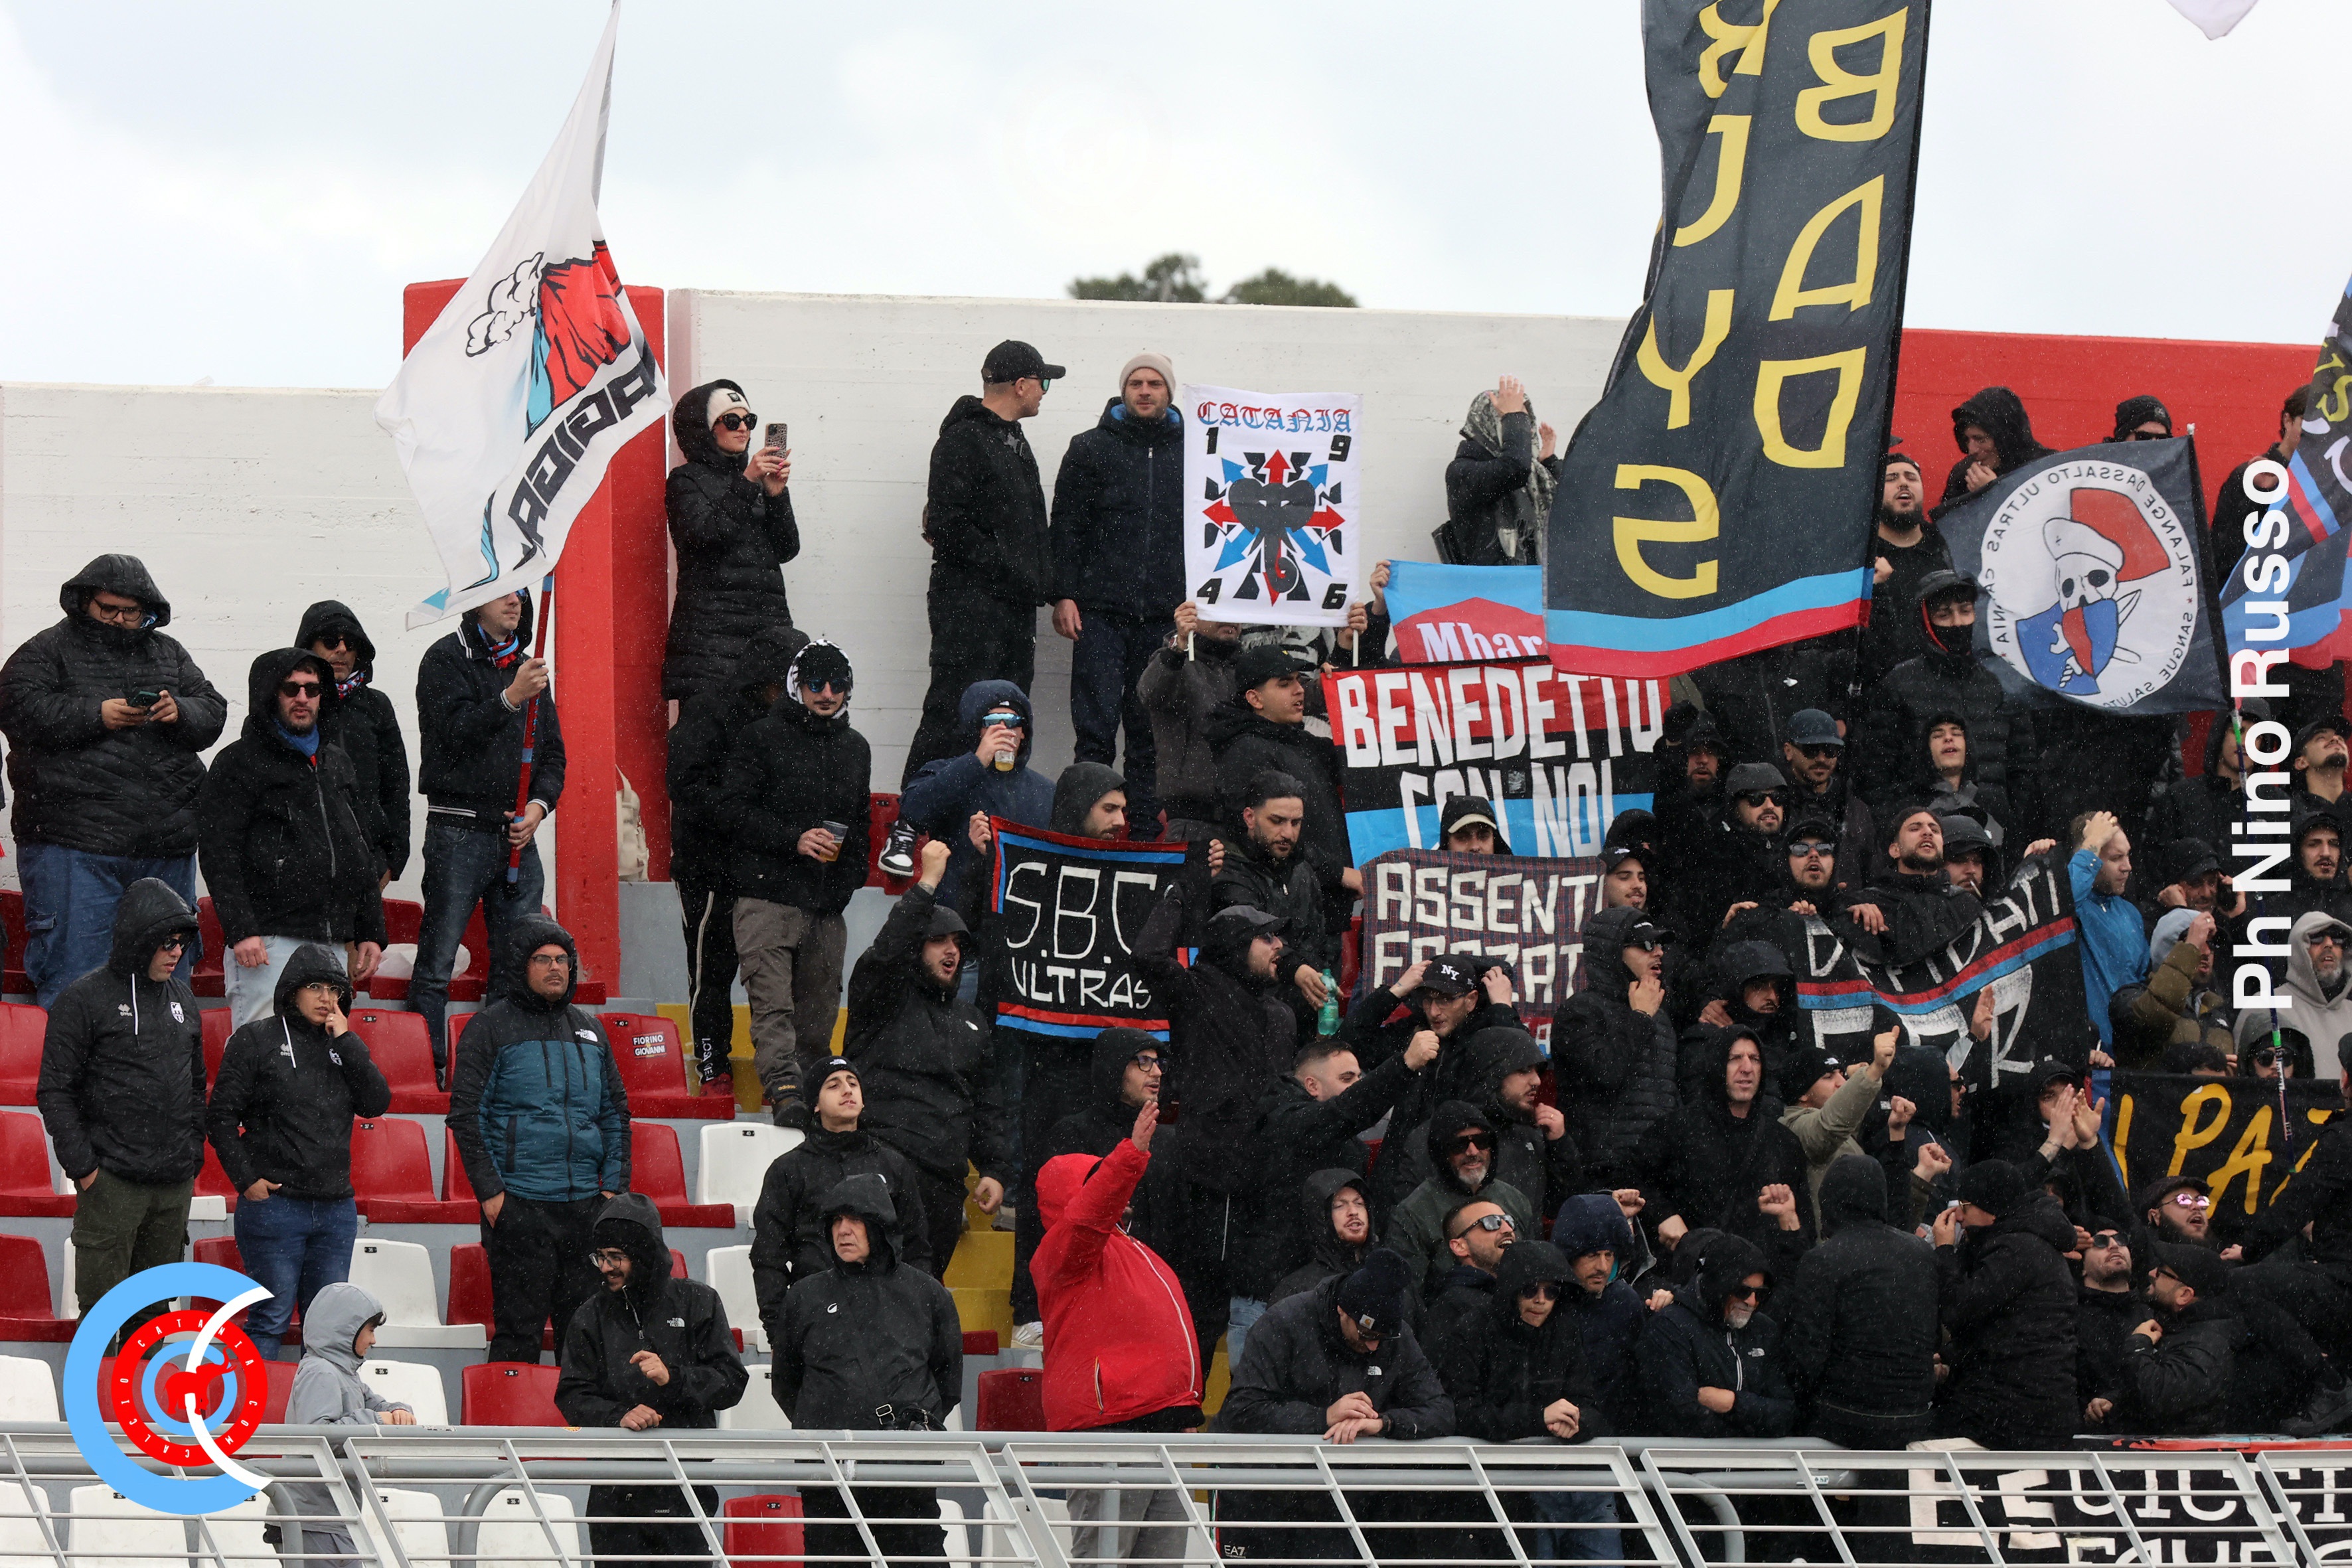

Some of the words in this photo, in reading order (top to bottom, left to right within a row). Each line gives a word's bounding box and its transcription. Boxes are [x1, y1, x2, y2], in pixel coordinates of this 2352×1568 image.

[1197, 402, 1352, 433] CATANIA
[1206, 427, 1219, 455] 1
[1328, 435, 1352, 461] 9
[1197, 578, 1222, 604] 4
[1322, 584, 1348, 609] 6
[1336, 665, 1664, 767] BENEDETTO
[1530, 759, 1614, 857] NOI
[1441, 965, 1460, 980] NY
[633, 1034, 664, 1045] FIORINO
[635, 1045, 666, 1056] GIOVANNI
[1224, 1545, 1245, 1556] EA7
